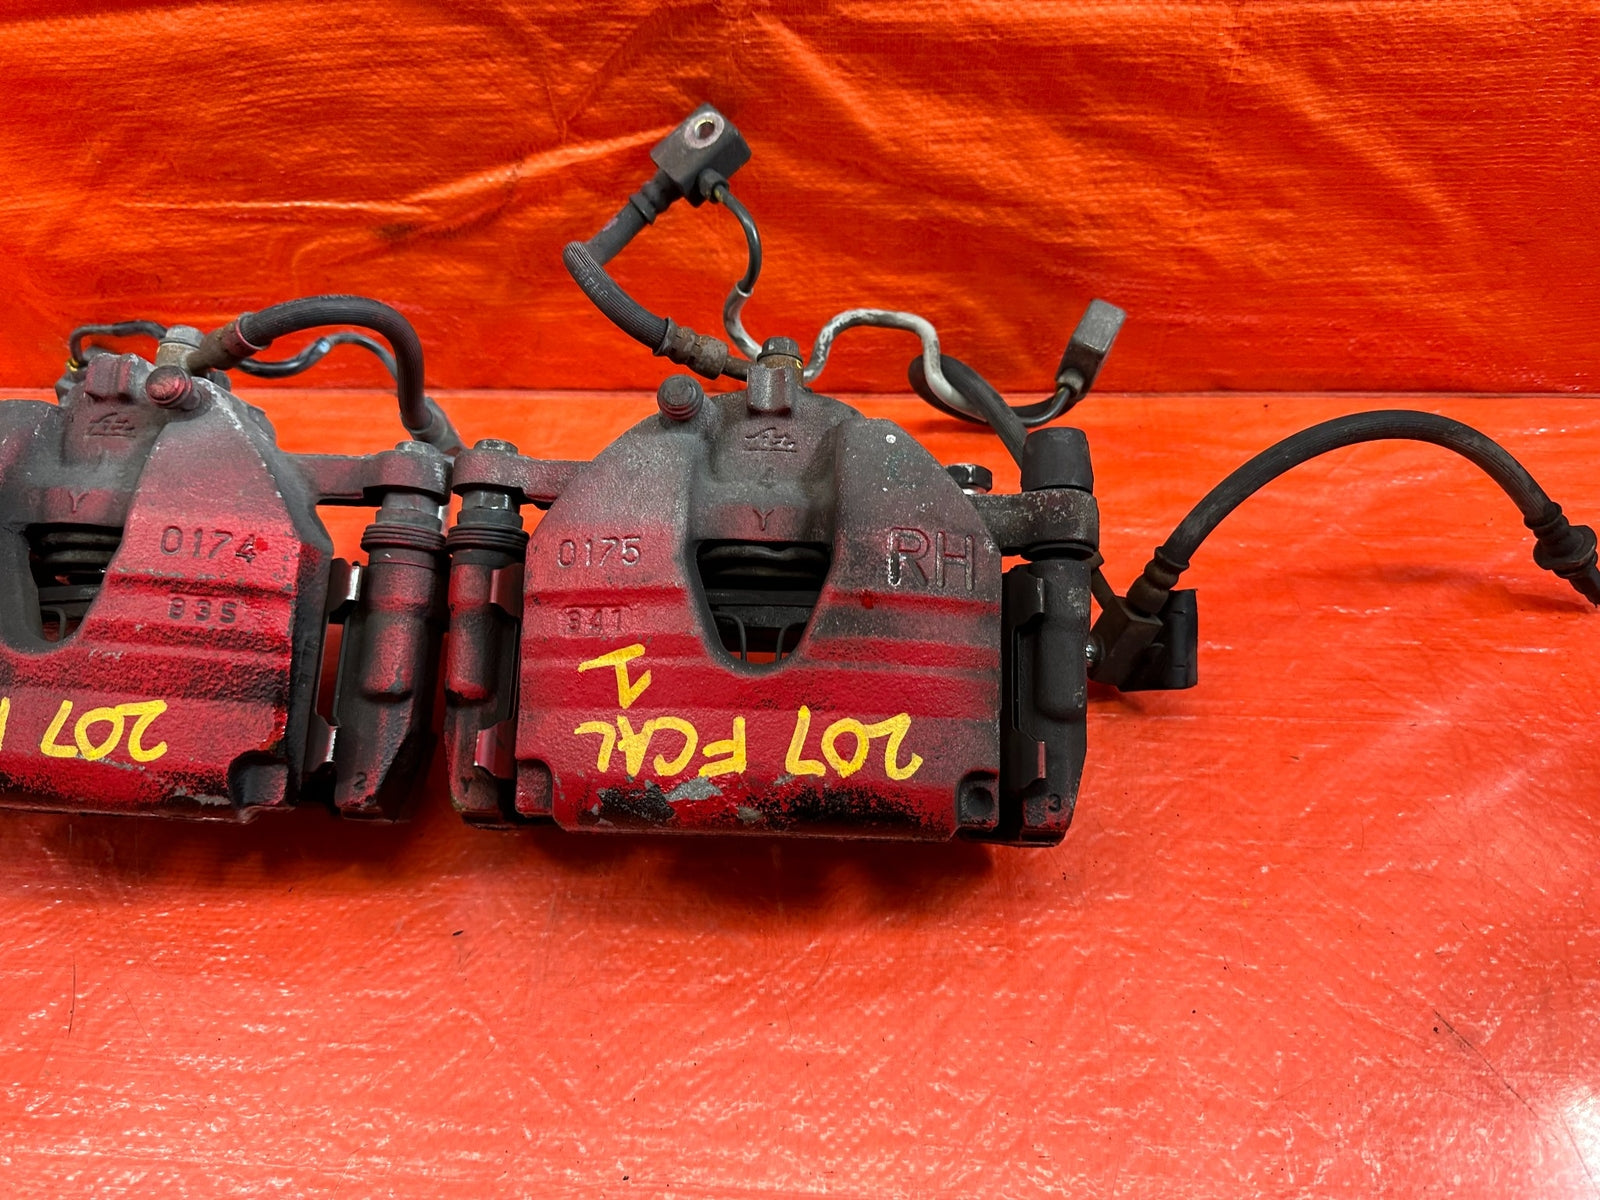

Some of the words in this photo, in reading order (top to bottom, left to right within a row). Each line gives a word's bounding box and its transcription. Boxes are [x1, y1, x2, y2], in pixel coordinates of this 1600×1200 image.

[161, 525, 257, 563] 0174
[752, 508, 775, 532] Y
[557, 535, 641, 569] 0175
[886, 526, 975, 592] RH
[578, 643, 652, 709] 1
[40, 700, 168, 761] 207
[574, 715, 747, 777] FCAL
[785, 705, 924, 780] 207
